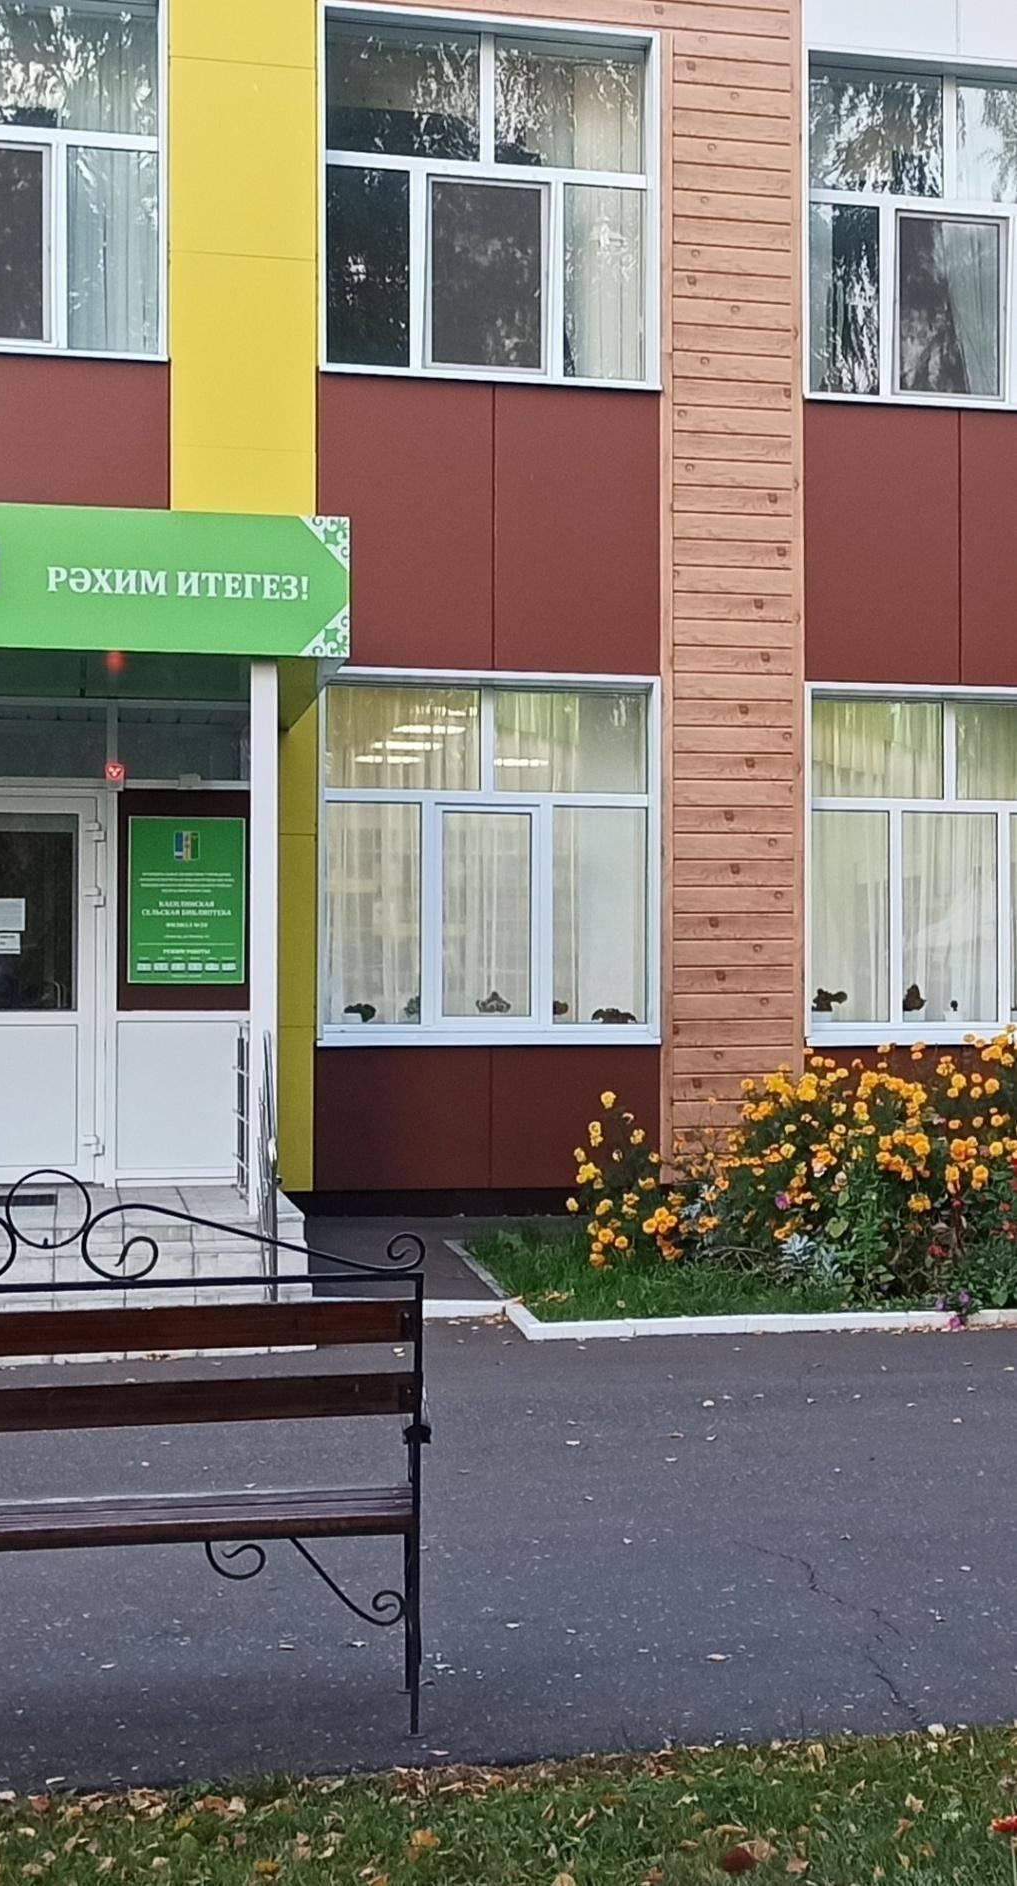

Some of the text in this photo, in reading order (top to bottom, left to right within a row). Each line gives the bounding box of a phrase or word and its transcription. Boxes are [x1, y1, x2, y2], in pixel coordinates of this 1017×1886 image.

[45, 565, 312, 602] РӘХИМ ИТЕГЕЗ!
[141, 908, 180, 916] СЕЛЬСКАЯ
